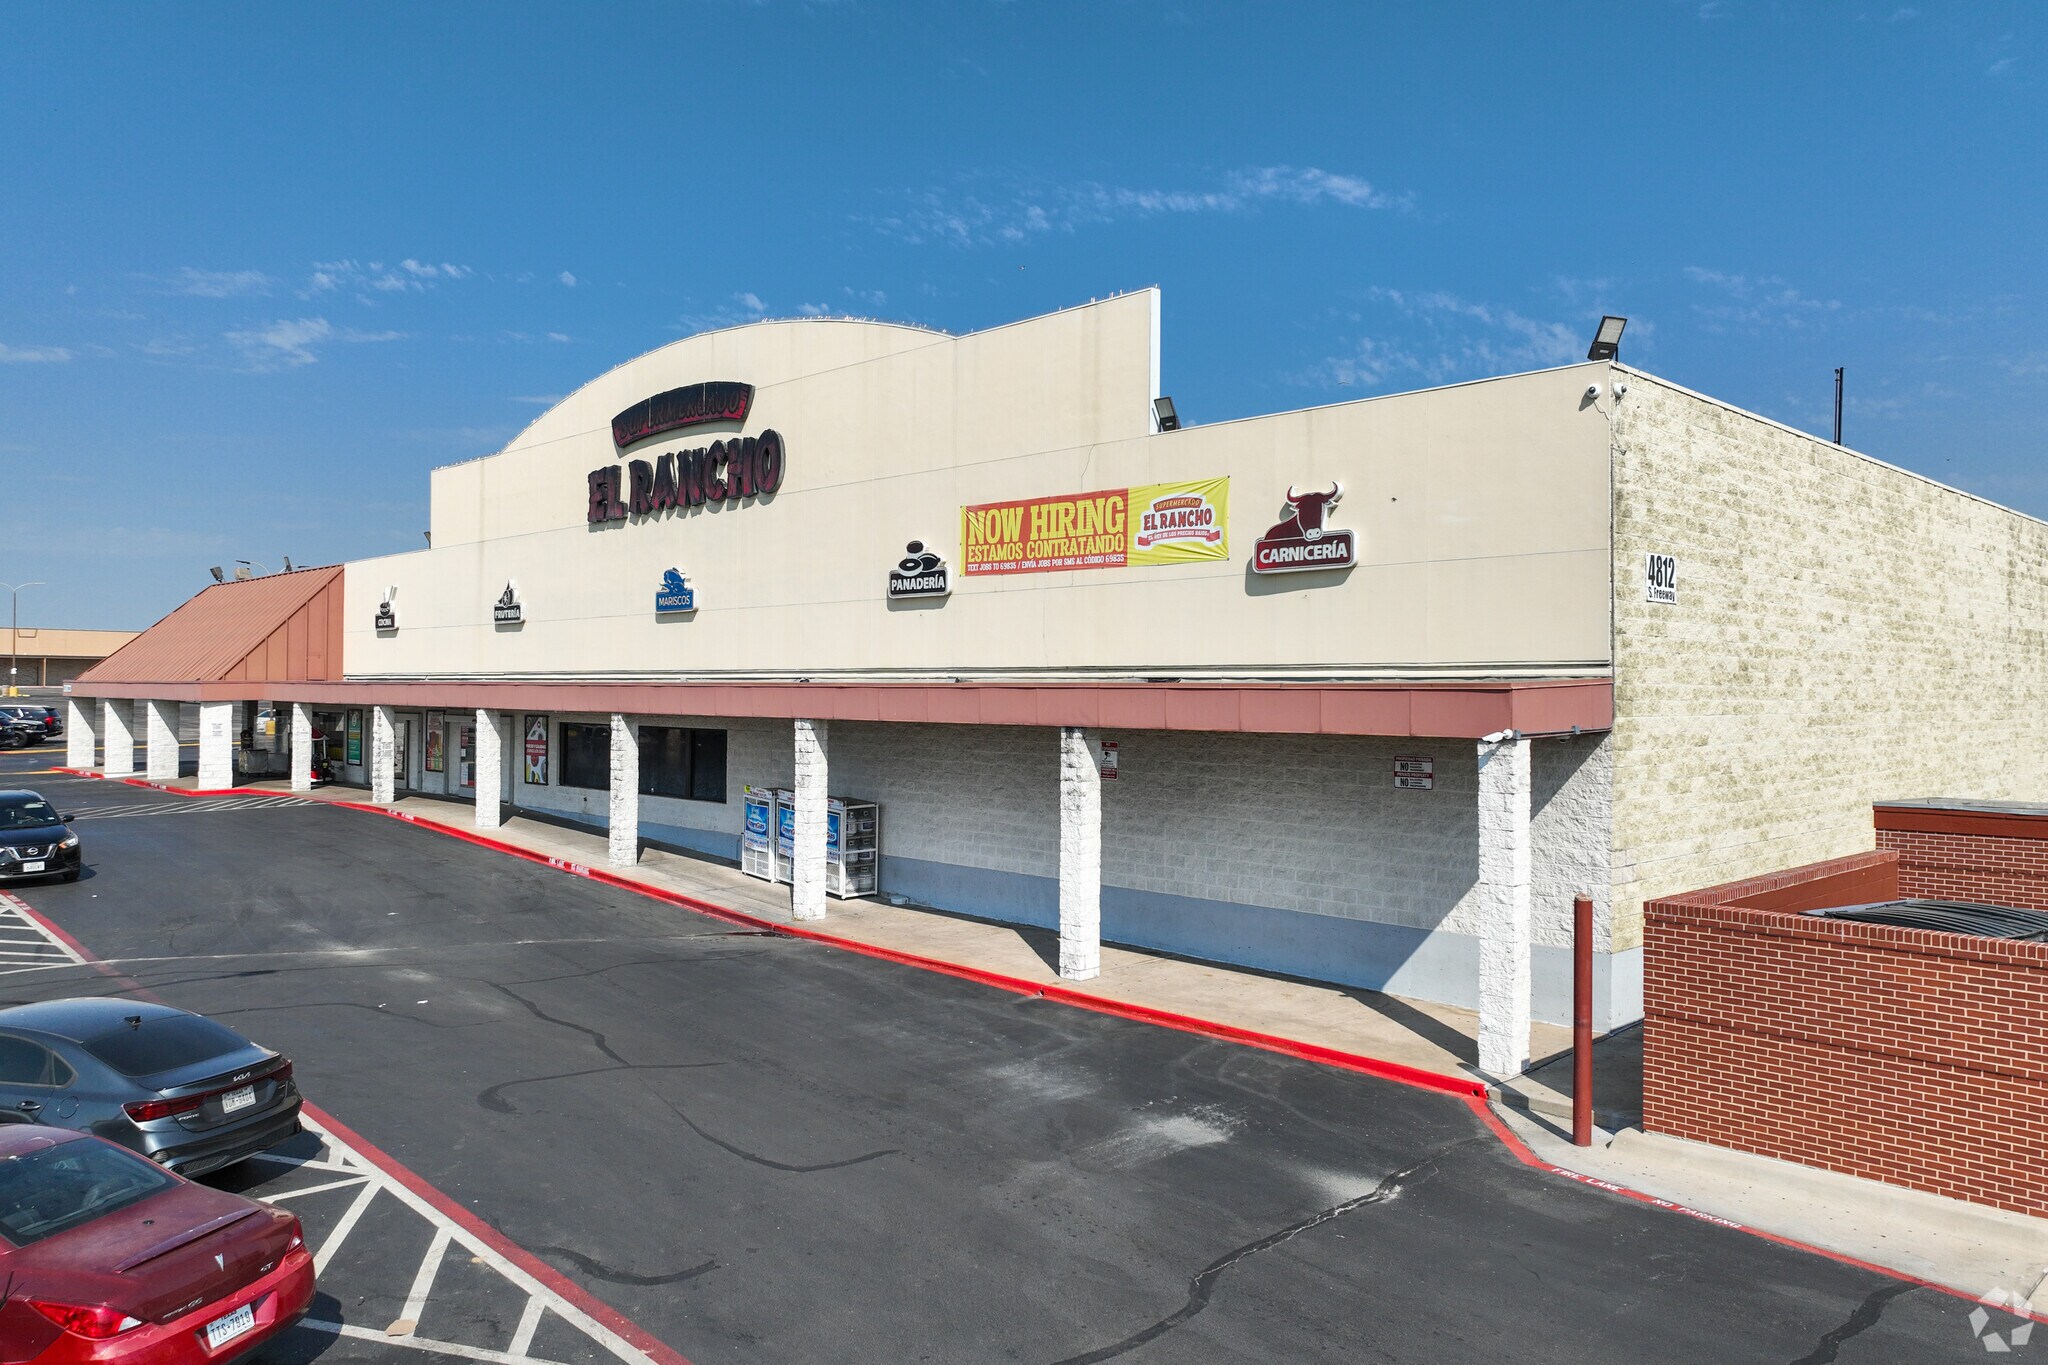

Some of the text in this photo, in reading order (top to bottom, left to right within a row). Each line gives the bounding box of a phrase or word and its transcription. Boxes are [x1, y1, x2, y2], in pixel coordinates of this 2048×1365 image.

[618, 391, 742, 440] SUPERMERCADO
[588, 429, 786, 523] EL RANCHO
[1155, 499, 1201, 510] SUPERMERCADO
[967, 495, 1125, 545] NOW HIRING
[1143, 508, 1213, 531] EL RANCHO
[967, 533, 1125, 563] ESTAMOS CONTRATANDO
[1259, 540, 1349, 564] CARNICERÍA
[967, 563, 979, 572] TEXT
[979, 562, 992, 571] JOBS
[993, 562, 1000, 570] TO
[1051, 558, 1063, 567] POR
[1063, 557, 1076, 566] SMS
[1076, 556, 1083, 565] AL
[1648, 554, 1675, 589] 4812
[891, 574, 945, 591] PANADERÍA
[658, 595, 691, 607] MARISCOS
[1400, 762, 1409, 771] NO
[1400, 778, 1409, 787] NO
[1551, 1167, 1743, 1229] FIRE LANE NO PARKING
[260, 1261, 274, 1272] GT
[210, 1310, 252, 1341] TTS-7919
